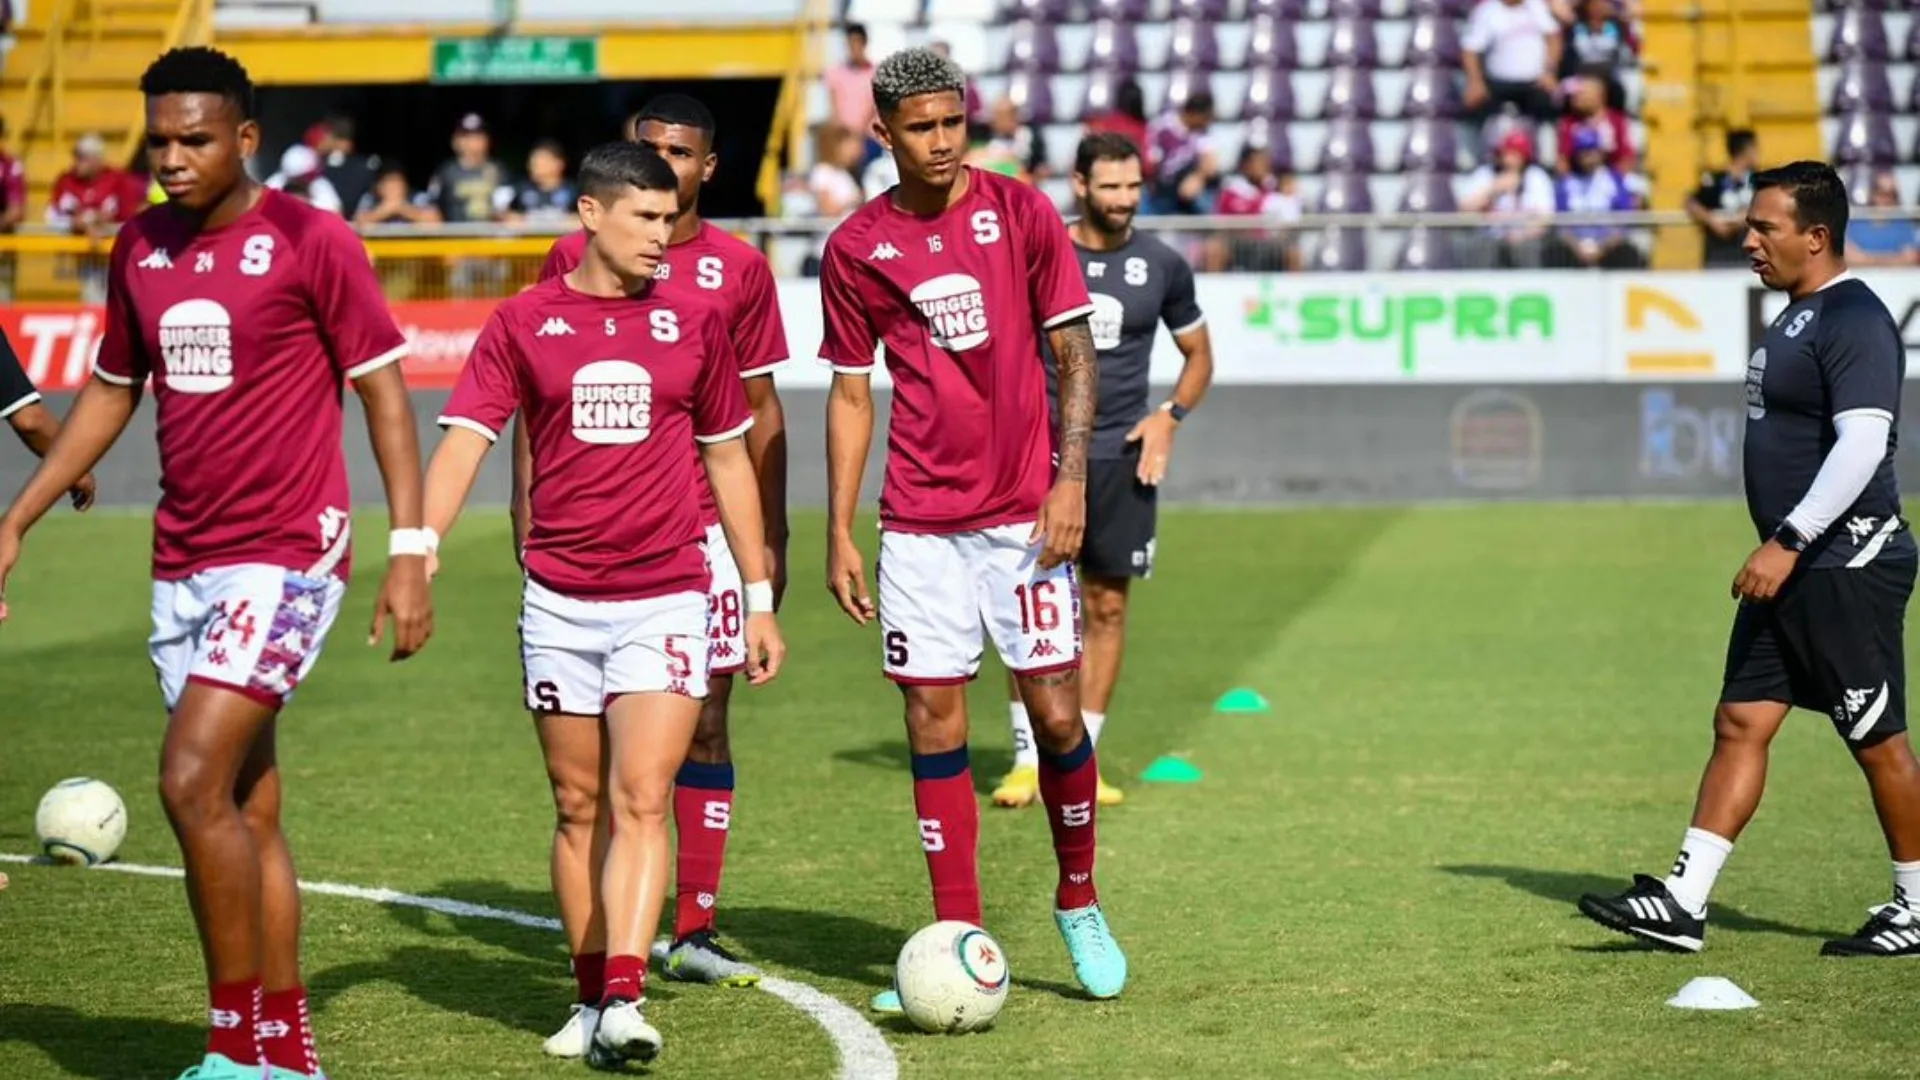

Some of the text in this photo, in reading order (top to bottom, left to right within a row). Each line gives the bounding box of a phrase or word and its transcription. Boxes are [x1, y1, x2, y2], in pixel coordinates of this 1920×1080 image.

[971, 210, 1001, 245] S
[239, 234, 275, 275] S
[926, 234, 943, 253] 16
[194, 252, 213, 272] 24
[696, 256, 723, 290] S
[916, 292, 984, 317] URGER
[159, 327, 231, 347] BURGER
[605, 318, 616, 336] 5
[649, 309, 679, 343] S
[930, 309, 987, 337] ING
[1785, 309, 1814, 338] S
[20, 313, 105, 385] Ti
[572, 385, 652, 403] BURGER
[572, 402, 651, 428] KING
[709, 589, 740, 638] 28
[1014, 580, 1060, 634] 16
[665, 633, 692, 678] 5
[886, 631, 908, 667] S
[535, 681, 561, 713] S
[704, 801, 730, 830] S
[1061, 801, 1091, 827] S
[919, 819, 945, 852] S
